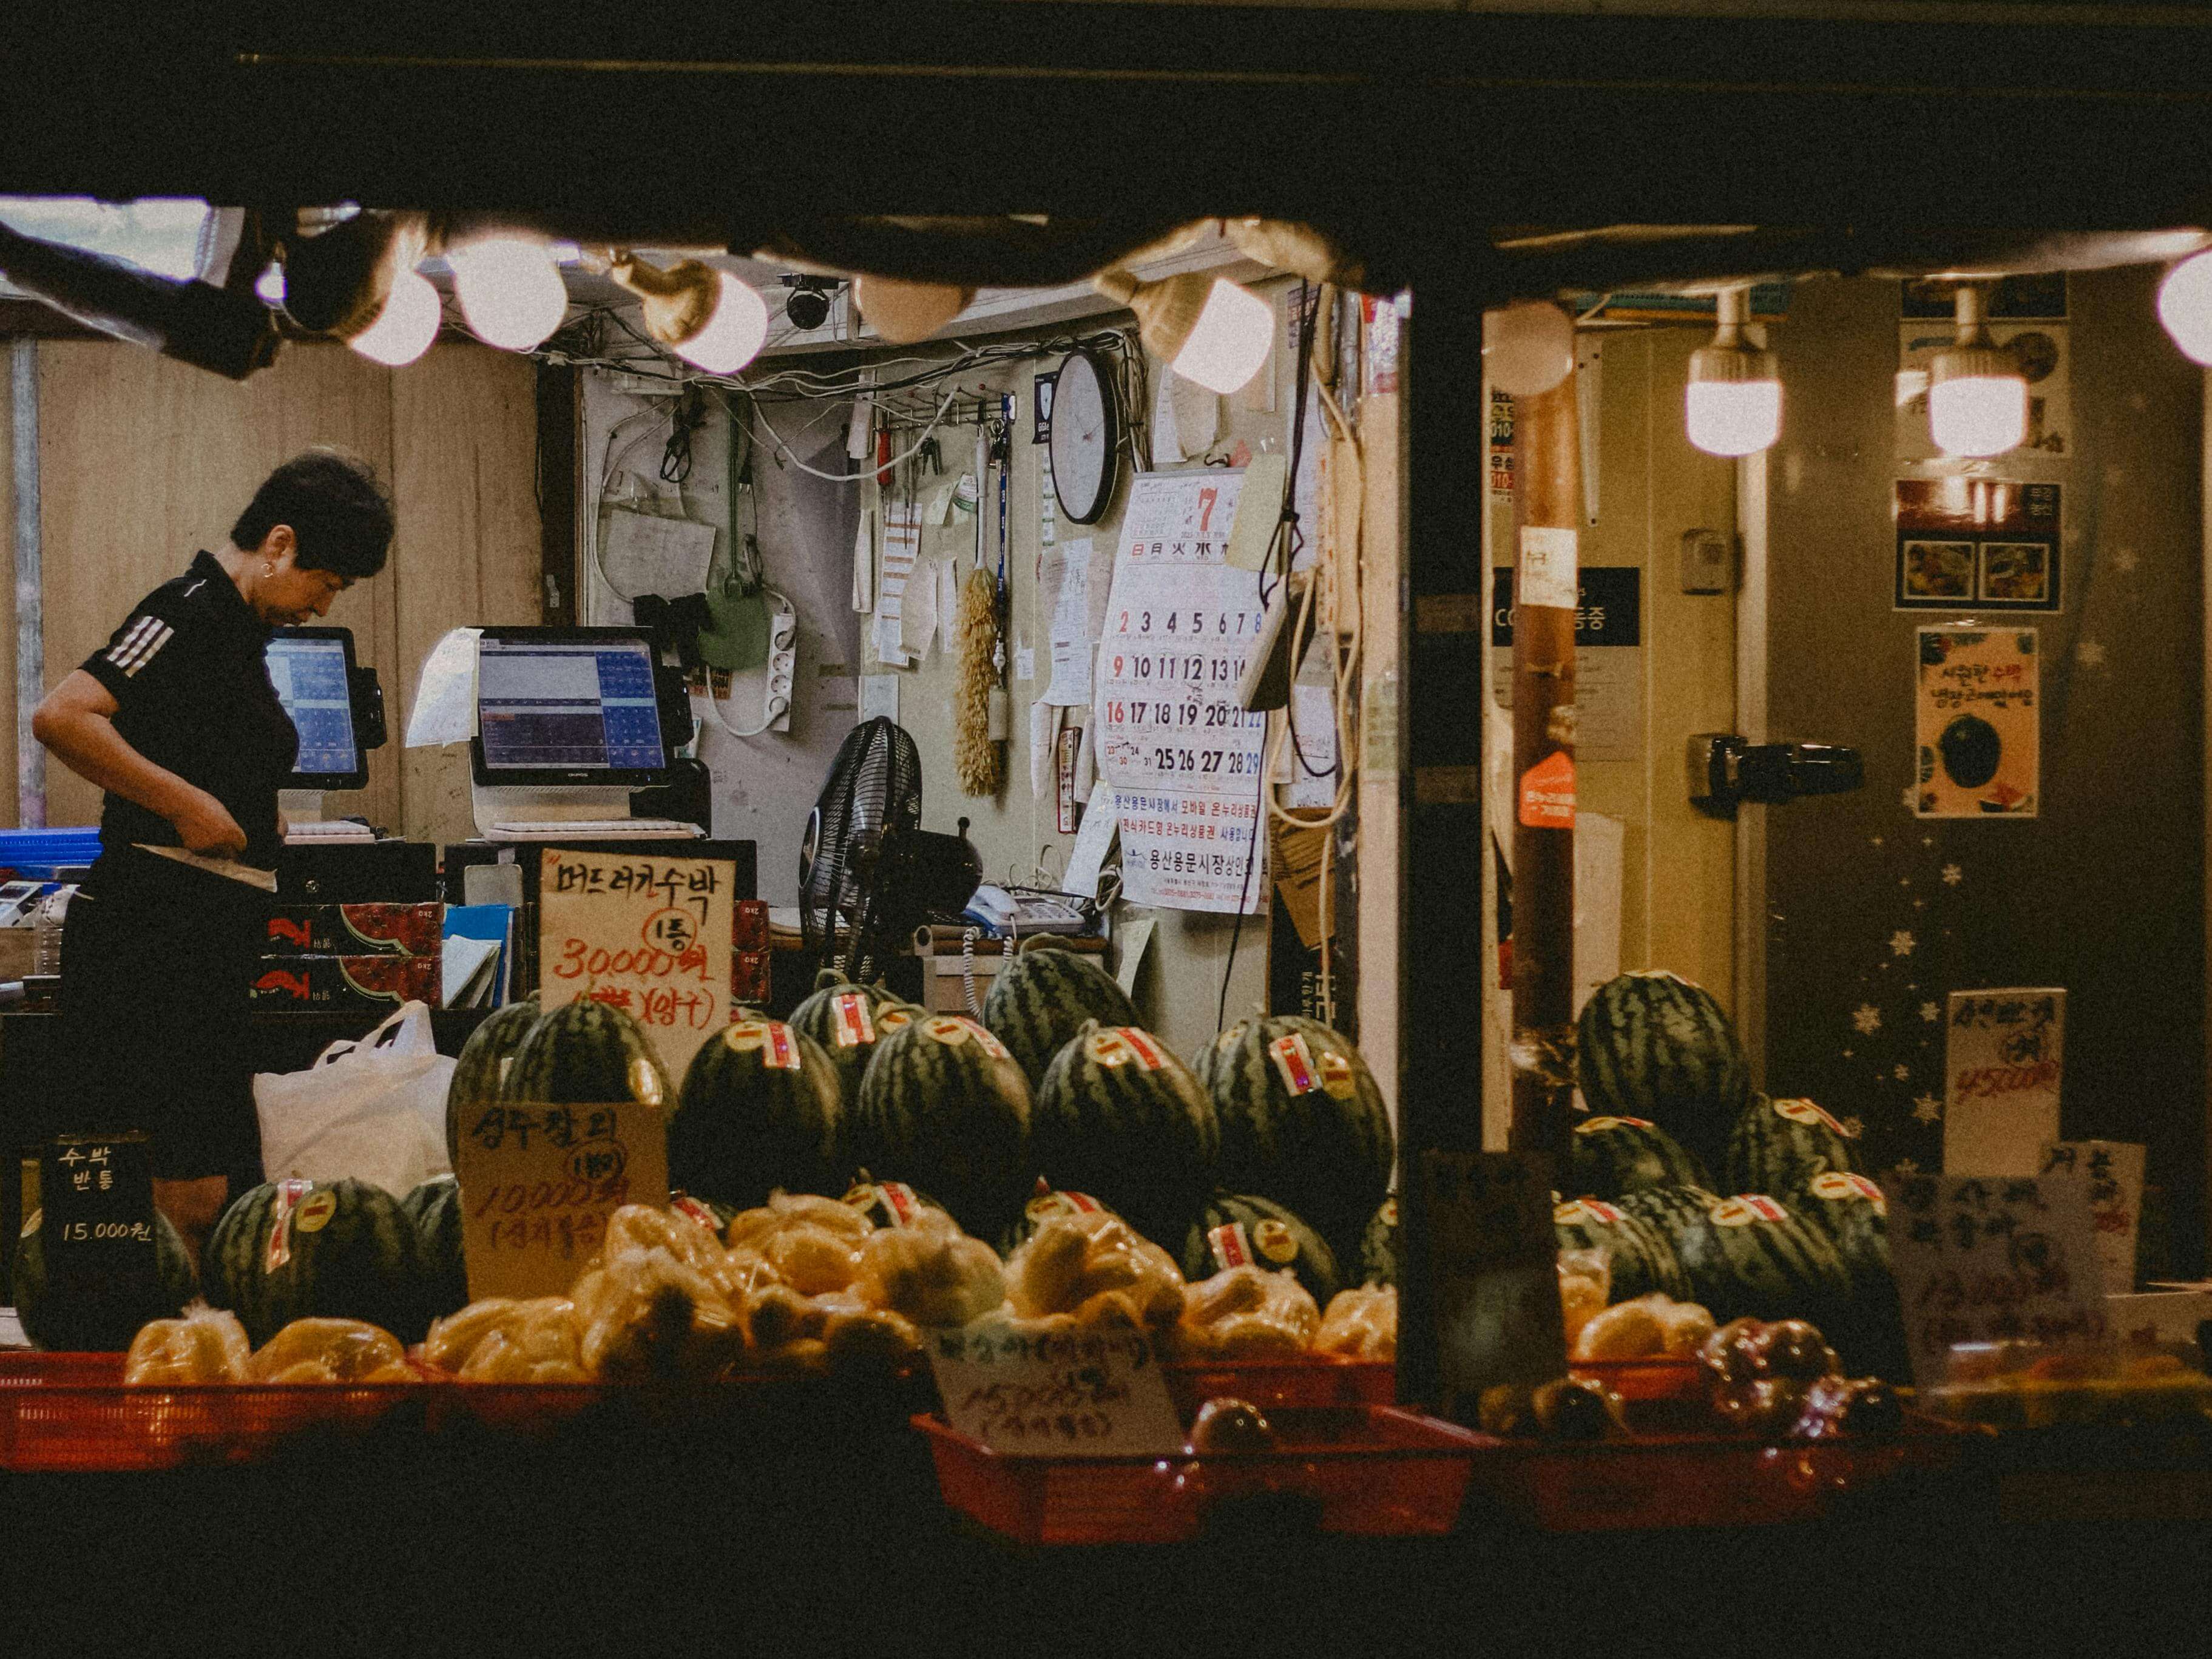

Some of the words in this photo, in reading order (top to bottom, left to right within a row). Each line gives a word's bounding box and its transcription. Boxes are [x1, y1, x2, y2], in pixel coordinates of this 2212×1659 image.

[1198, 487, 1219, 532] 7
[1131, 543, 1145, 556] 日
[1151, 542, 1163, 555] 月
[1172, 542, 1186, 555] 火
[1195, 542, 1211, 556] 水
[1119, 611, 1129, 632] 2
[1141, 611, 1151, 632] 3
[1167, 612, 1177, 633] 4
[1192, 612, 1203, 634] 5
[1219, 613, 1226, 634] 6
[1236, 613, 1245, 634] 7
[1254, 613, 1262, 634] 8
[1113, 655, 1123, 677] 9
[1134, 656, 1151, 678] 10
[1159, 657, 1176, 678] 11
[1183, 658, 1202, 680] 12
[1211, 659, 1228, 681] 13
[1107, 701, 1125, 723] 16
[1131, 702, 1148, 724] 17
[1155, 703, 1171, 725] 18
[1179, 704, 1198, 726] 19
[1205, 704, 1226, 726] 20
[1233, 706, 1245, 728] 21
[1107, 746, 1115, 755] 23
[1130, 746, 1140, 756] 24
[1155, 748, 1175, 771] 25
[1179, 749, 1195, 771] 26
[1201, 750, 1223, 773] 27
[1228, 752, 1243, 774] 28
[1246, 752, 1259, 774] 29
[1119, 756, 1128, 766] 30
[1144, 757, 1152, 767] 31
[1182, 800, 1206, 816] 모바일
[58, 1146, 112, 1167] 수박
